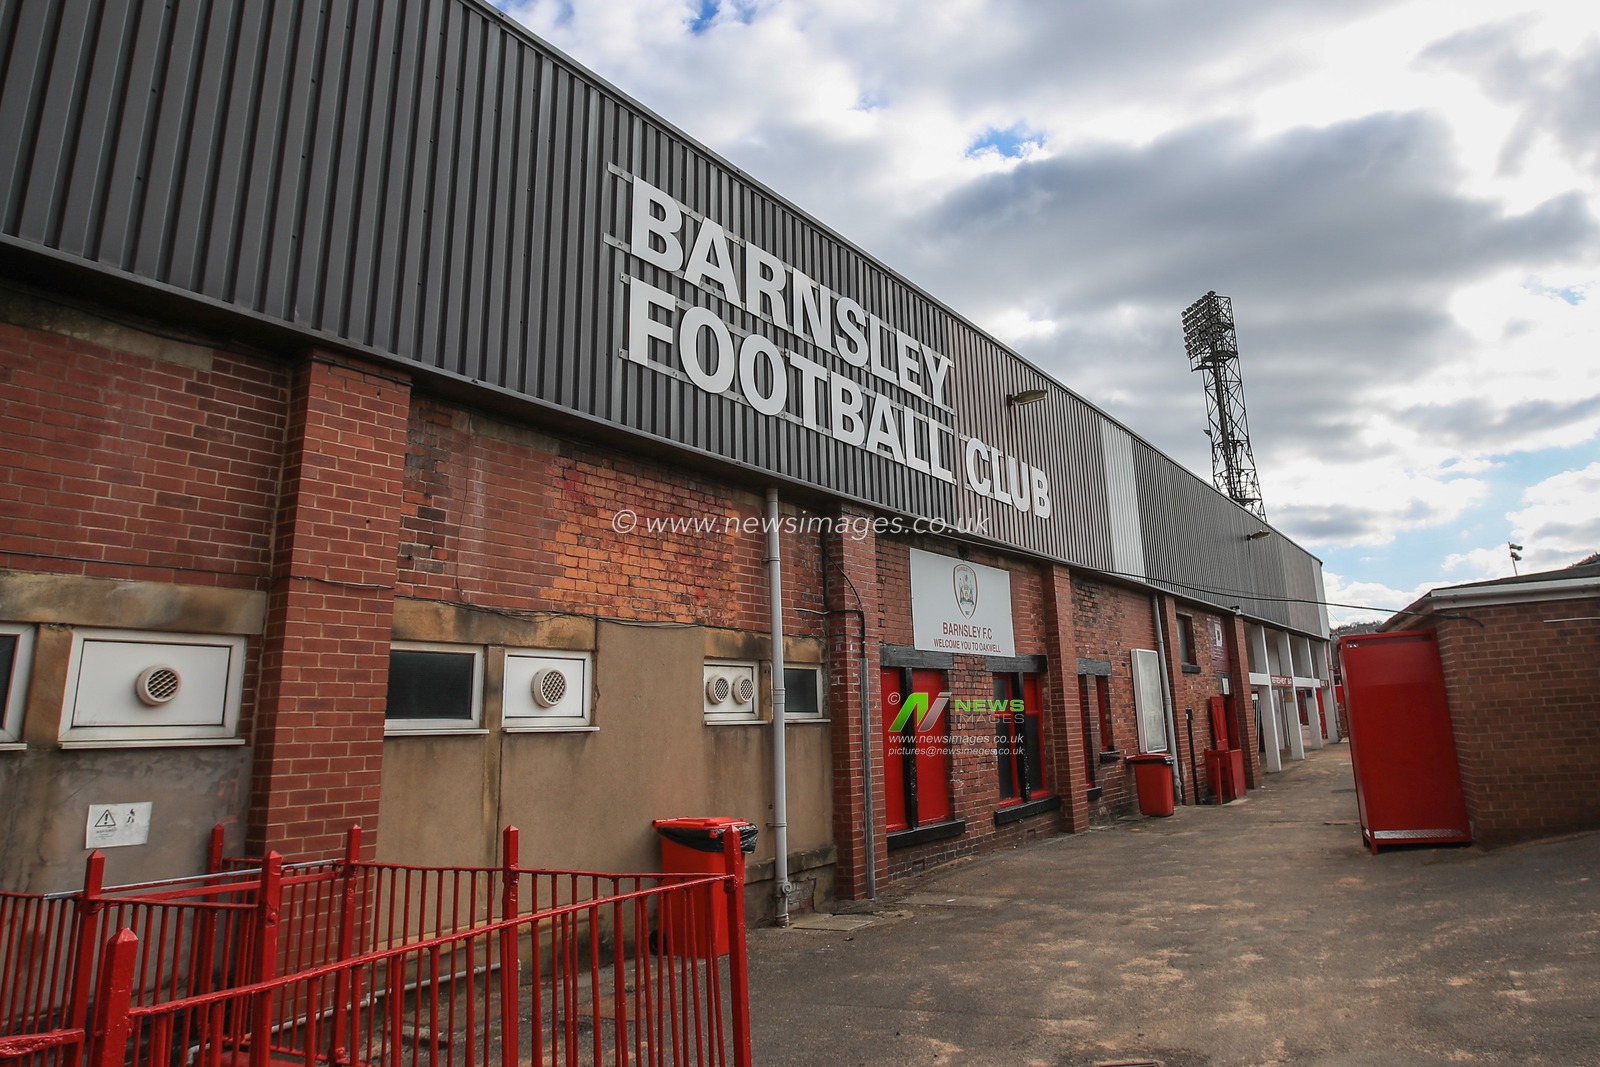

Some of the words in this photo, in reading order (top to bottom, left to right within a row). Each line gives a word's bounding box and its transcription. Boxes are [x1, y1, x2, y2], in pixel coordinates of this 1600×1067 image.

[631, 176, 954, 408] BARNSLEY
[628, 276, 954, 485] FOOTBALL
[964, 437, 1052, 520] CLUB
[933, 638, 960, 649] WELCOME
[960, 641, 972, 651] YOU
[972, 642, 979, 651] TO
[979, 643, 1001, 653] OAKWELL
[942, 621, 981, 639] BARNSLEY
